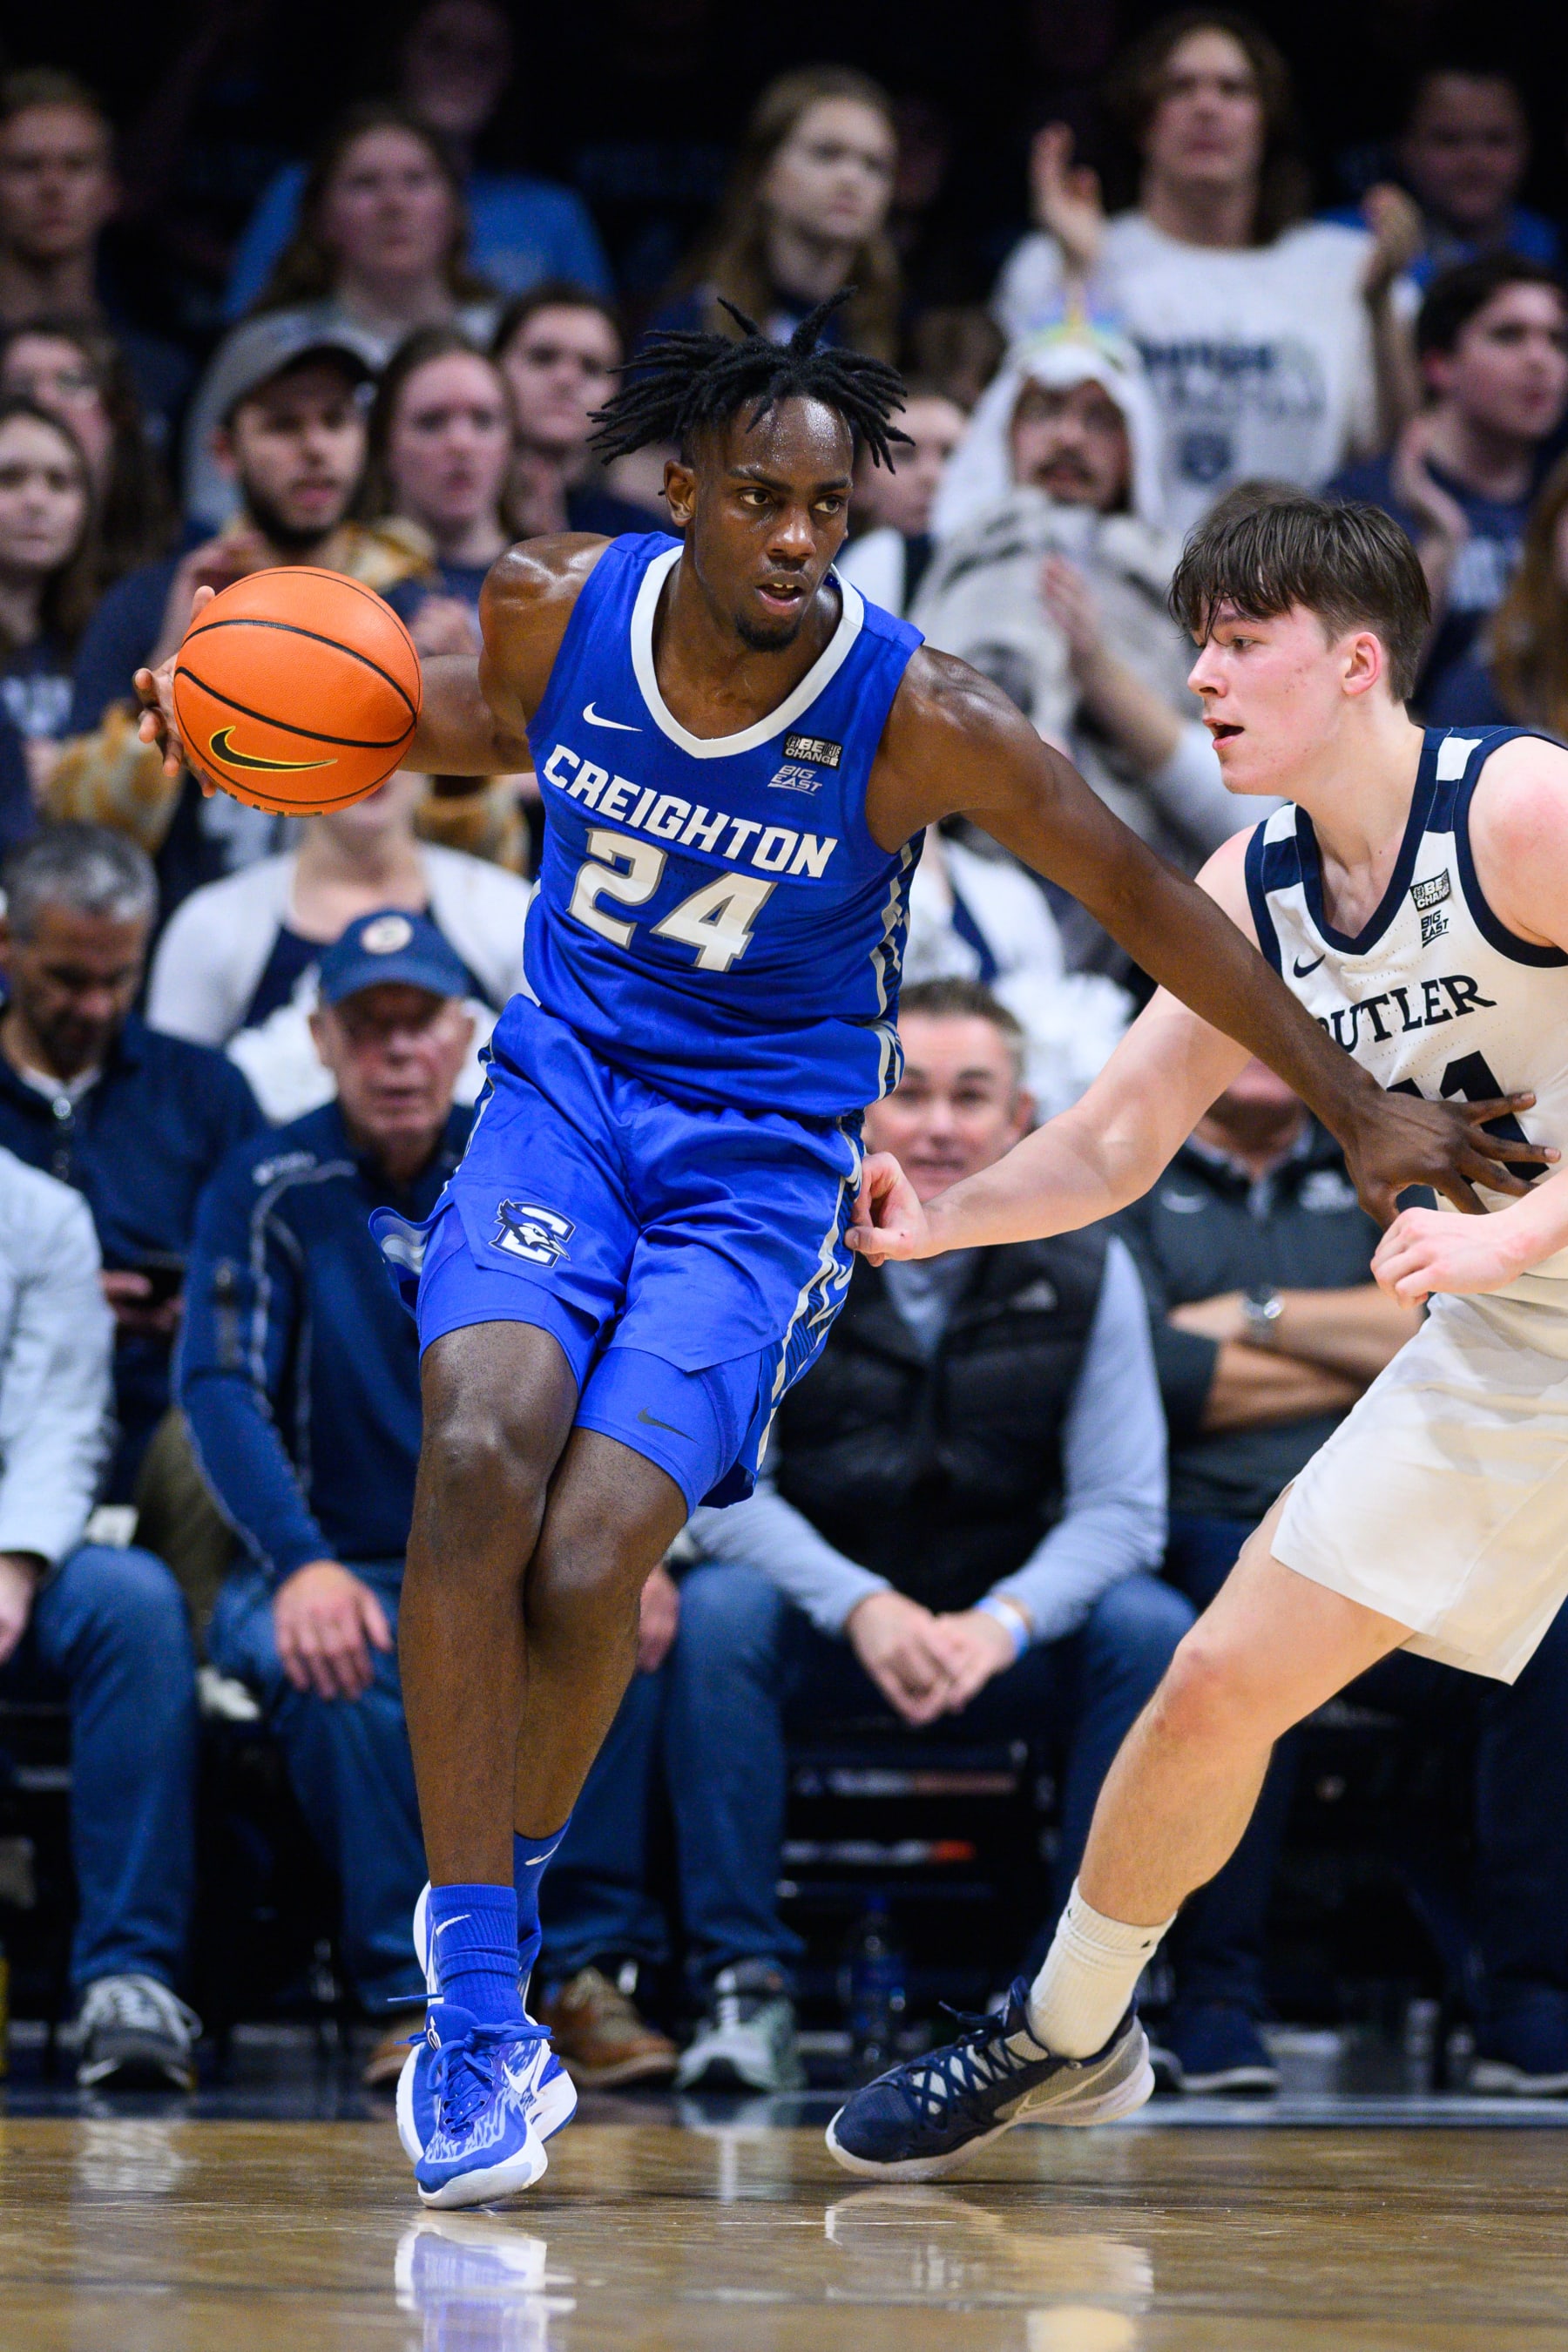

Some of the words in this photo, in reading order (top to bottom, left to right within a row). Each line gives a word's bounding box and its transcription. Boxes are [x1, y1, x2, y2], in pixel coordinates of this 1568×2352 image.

[785, 747, 839, 767] CHANGE
[779, 765, 817, 780] BIG
[770, 774, 822, 792] EAST
[543, 745, 838, 878] CREIGHTON
[566, 828, 778, 972] 24
[1421, 909, 1442, 929] BIG
[1422, 918, 1450, 942] EAST
